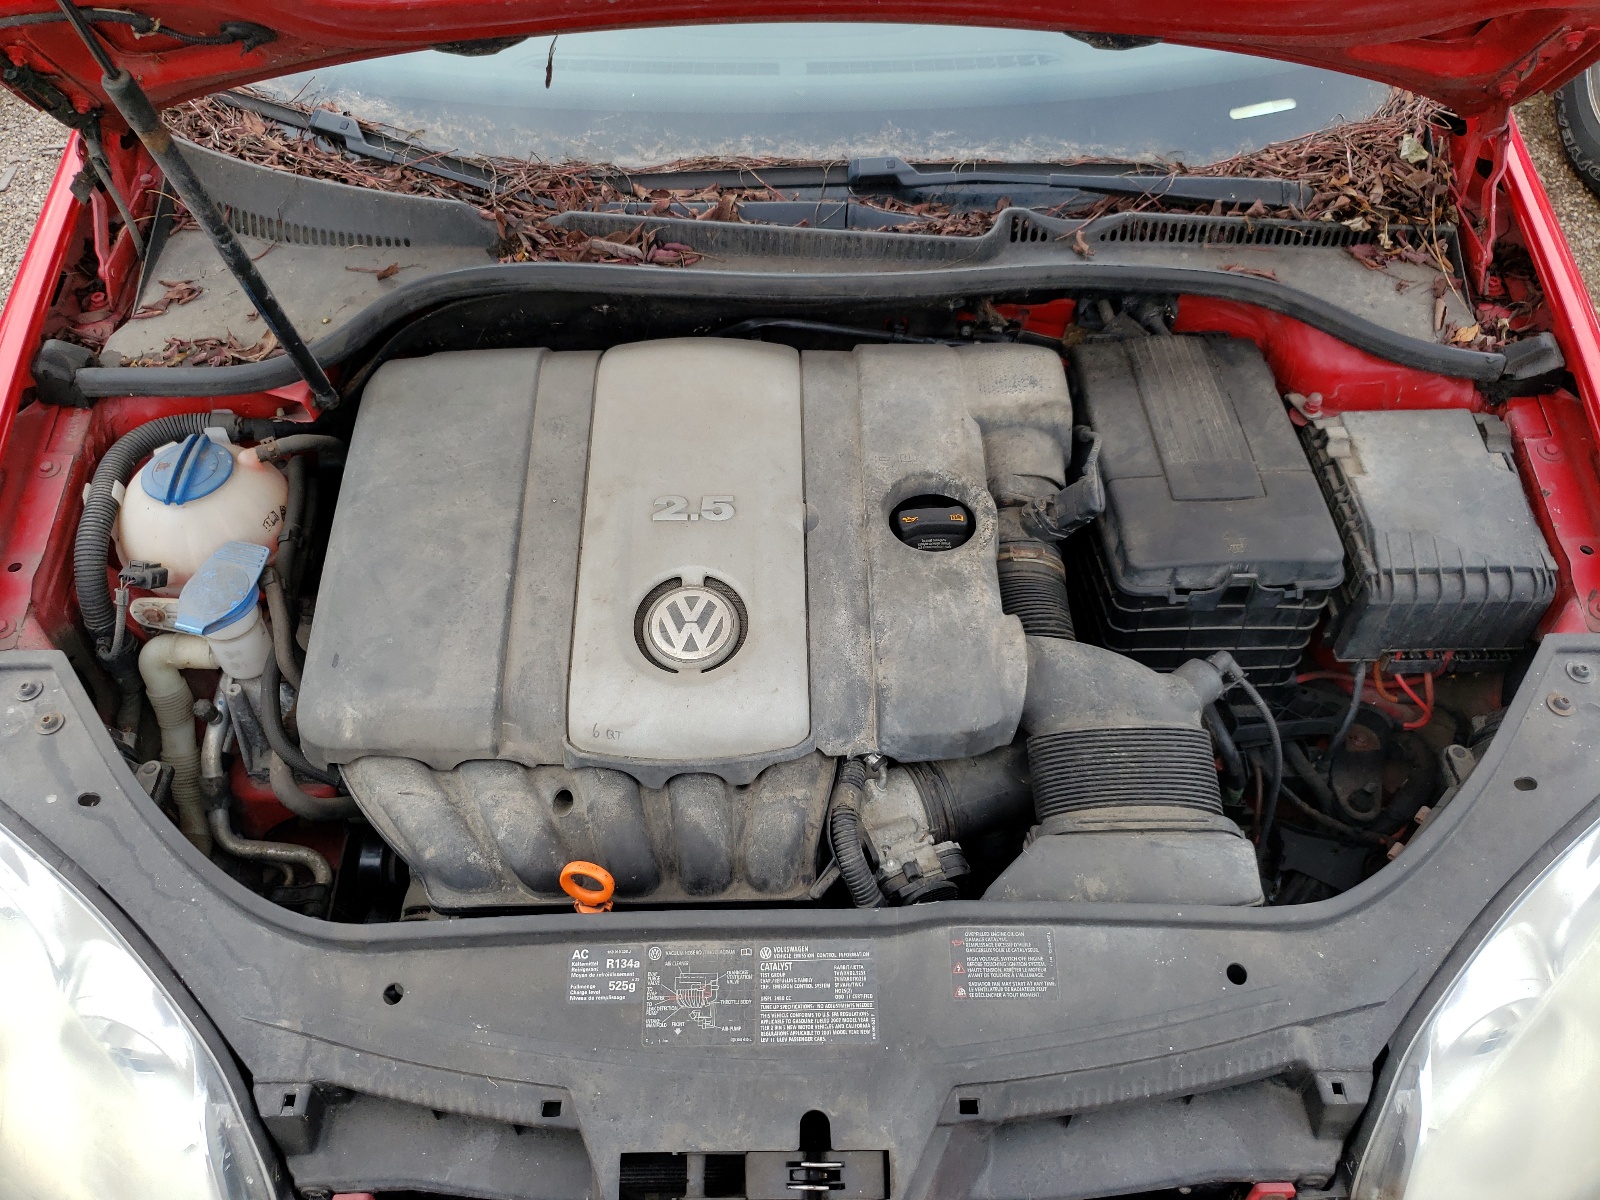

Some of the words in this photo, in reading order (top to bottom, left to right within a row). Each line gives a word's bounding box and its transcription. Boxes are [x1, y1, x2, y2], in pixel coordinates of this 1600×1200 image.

[652, 495, 736, 522] 2.5
[650, 588, 732, 660] VW
[592, 723, 600, 739] 6
[572, 949, 589, 959] AC
[607, 959, 640, 968] R134a
[760, 962, 792, 970] CATALYST
[609, 981, 635, 992] 525g
